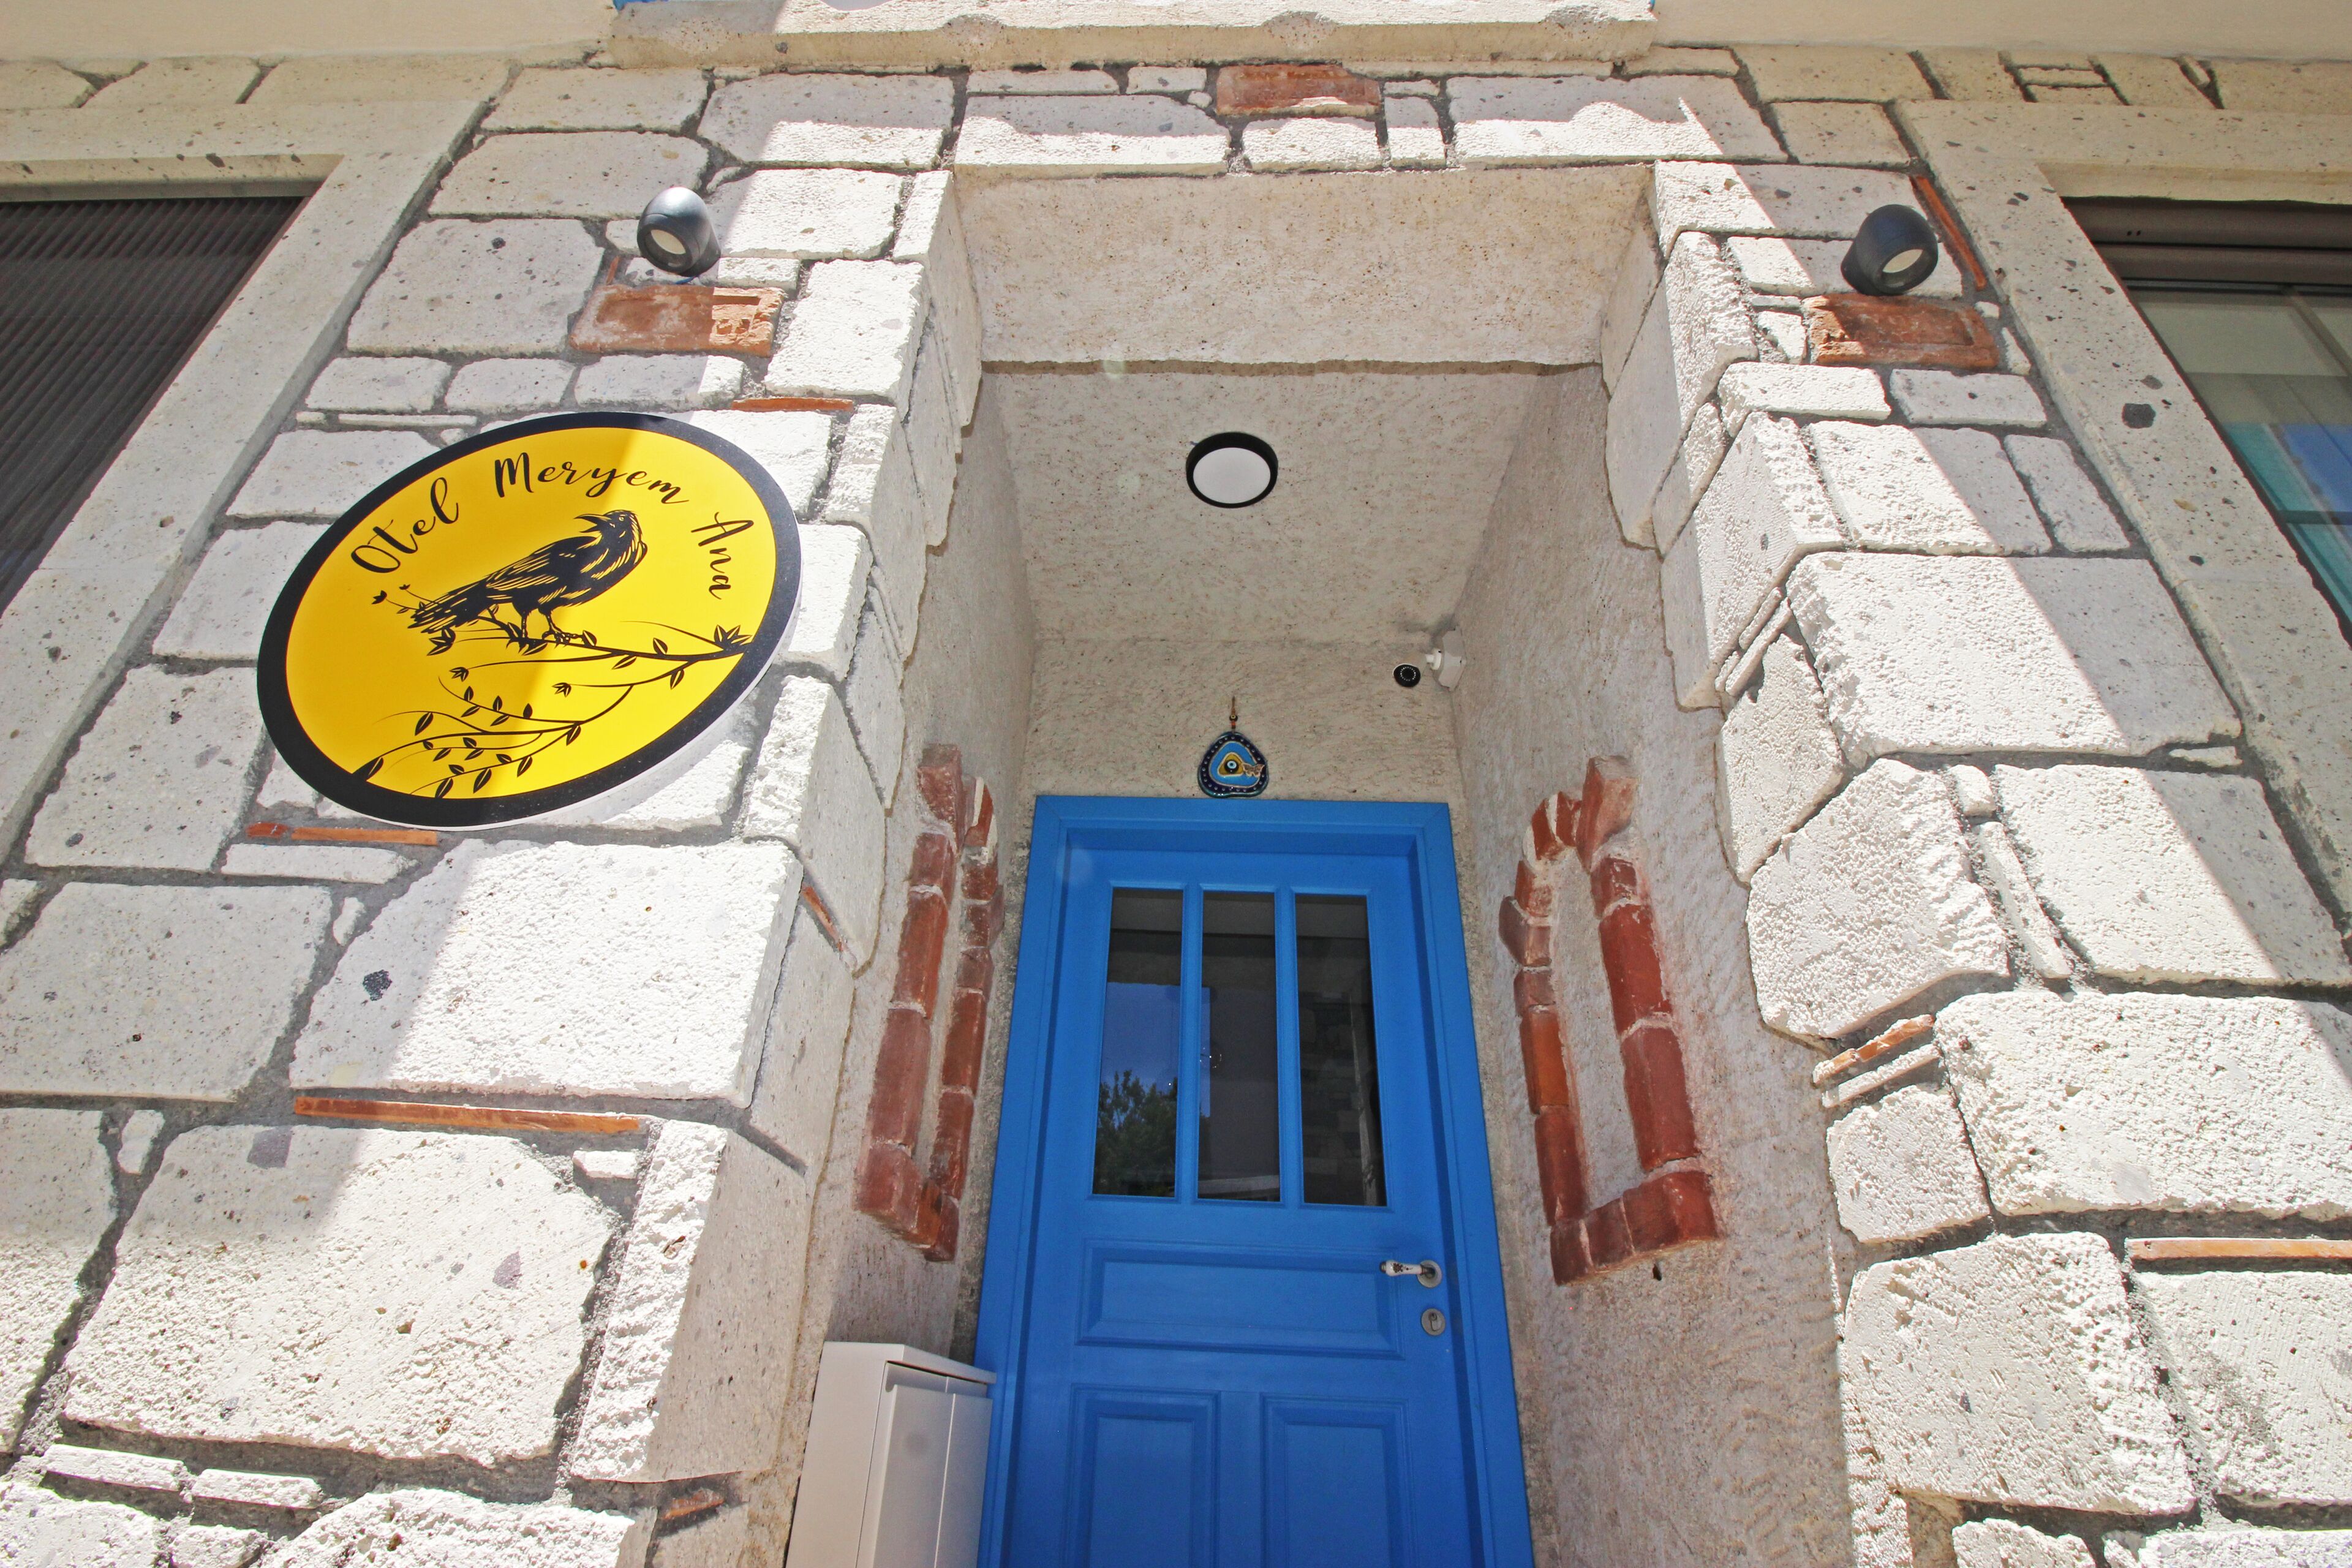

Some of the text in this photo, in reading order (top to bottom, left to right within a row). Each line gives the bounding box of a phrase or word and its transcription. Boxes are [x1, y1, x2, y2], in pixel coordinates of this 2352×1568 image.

[351, 452, 754, 599] Otel Meryem Ana
